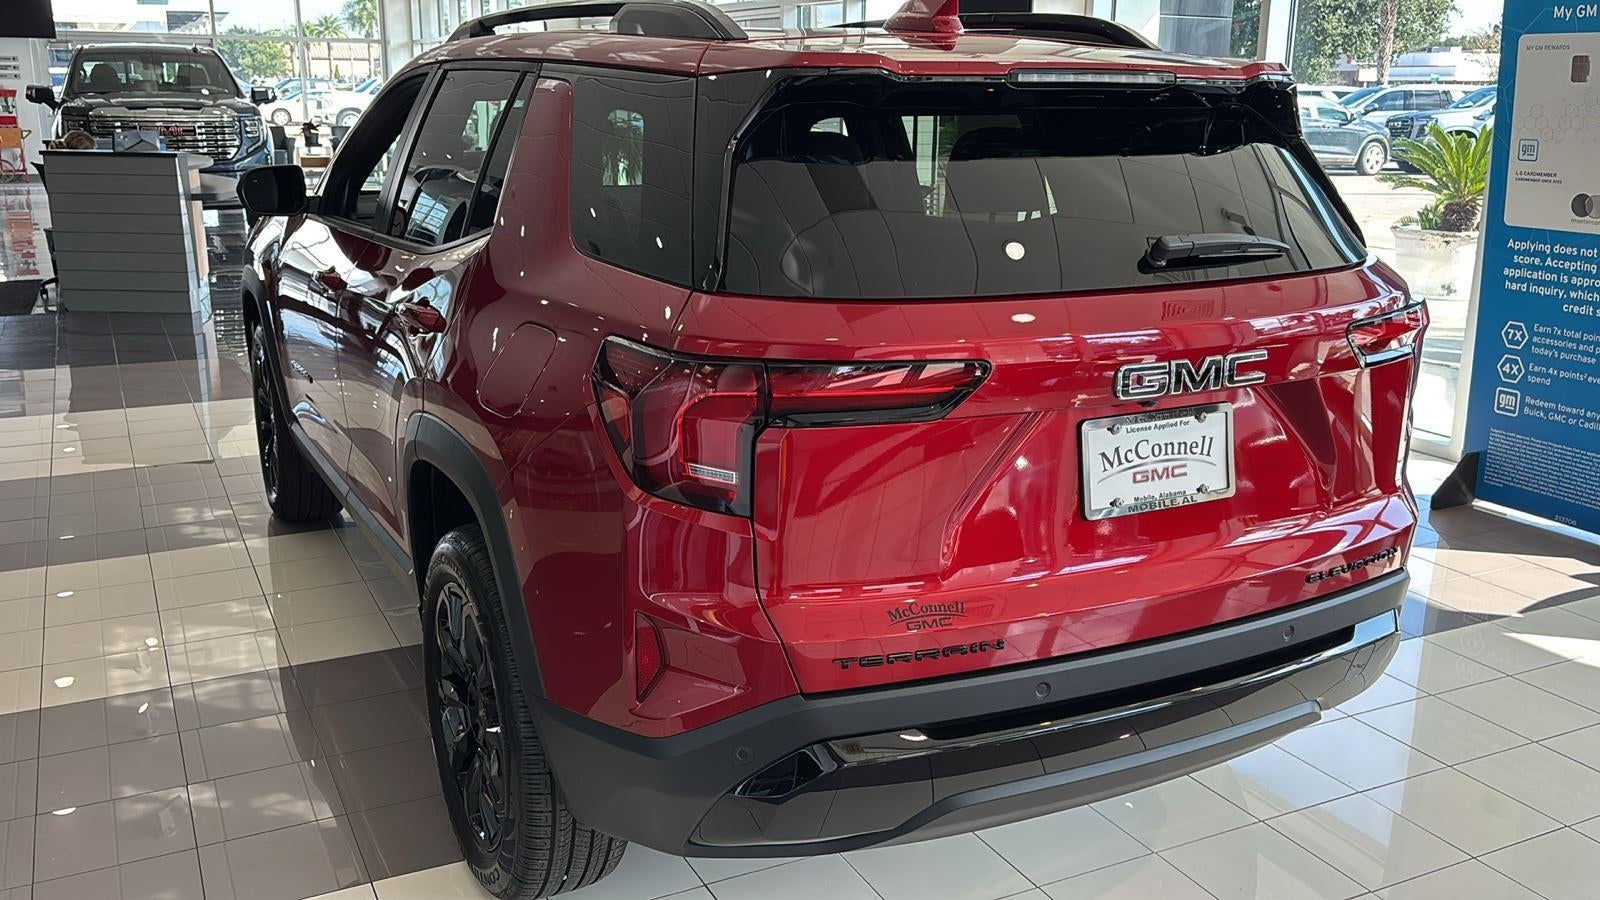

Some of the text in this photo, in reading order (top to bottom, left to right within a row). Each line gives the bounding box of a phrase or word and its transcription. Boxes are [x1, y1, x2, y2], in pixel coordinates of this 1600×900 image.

[1553, 4, 1598, 21] My GM
[1507, 238, 1598, 258] Applying does not
[1513, 254, 1597, 274] score. Accepting
[1503, 267, 1557, 282] application
[1560, 273, 1569, 283] is
[1505, 280, 1600, 302] hard inquiry, which
[1563, 304, 1593, 316] credit
[1506, 328, 1523, 341] 7X
[1533, 323, 1552, 333] Earn
[1553, 326, 1562, 336] 7x
[1563, 328, 1581, 339] total
[1532, 336, 1577, 349] accessories
[1578, 344, 1594, 352] and
[1531, 346, 1597, 364] today's purchase
[1114, 350, 1268, 401] GMC
[1502, 363, 1520, 376] 4X
[1529, 363, 1547, 373] Earn
[1547, 367, 1558, 376] 4x
[1527, 375, 1551, 386] spend
[1499, 393, 1516, 409] gm
[1525, 396, 1600, 420] Redeem toward any
[1523, 407, 1547, 420] Buick,
[1548, 412, 1567, 423] GMC
[1125, 425, 1152, 434] License
[1153, 421, 1178, 430] Applied
[1099, 435, 1214, 472] McConnell
[1132, 463, 1188, 484] GMC
[1133, 490, 1187, 502] Mobile, Alabama
[1182, 495, 1198, 504] AL
[887, 601, 965, 622] McConnell
[906, 617, 953, 631] GMC
[832, 639, 1006, 670] TERRAIN
